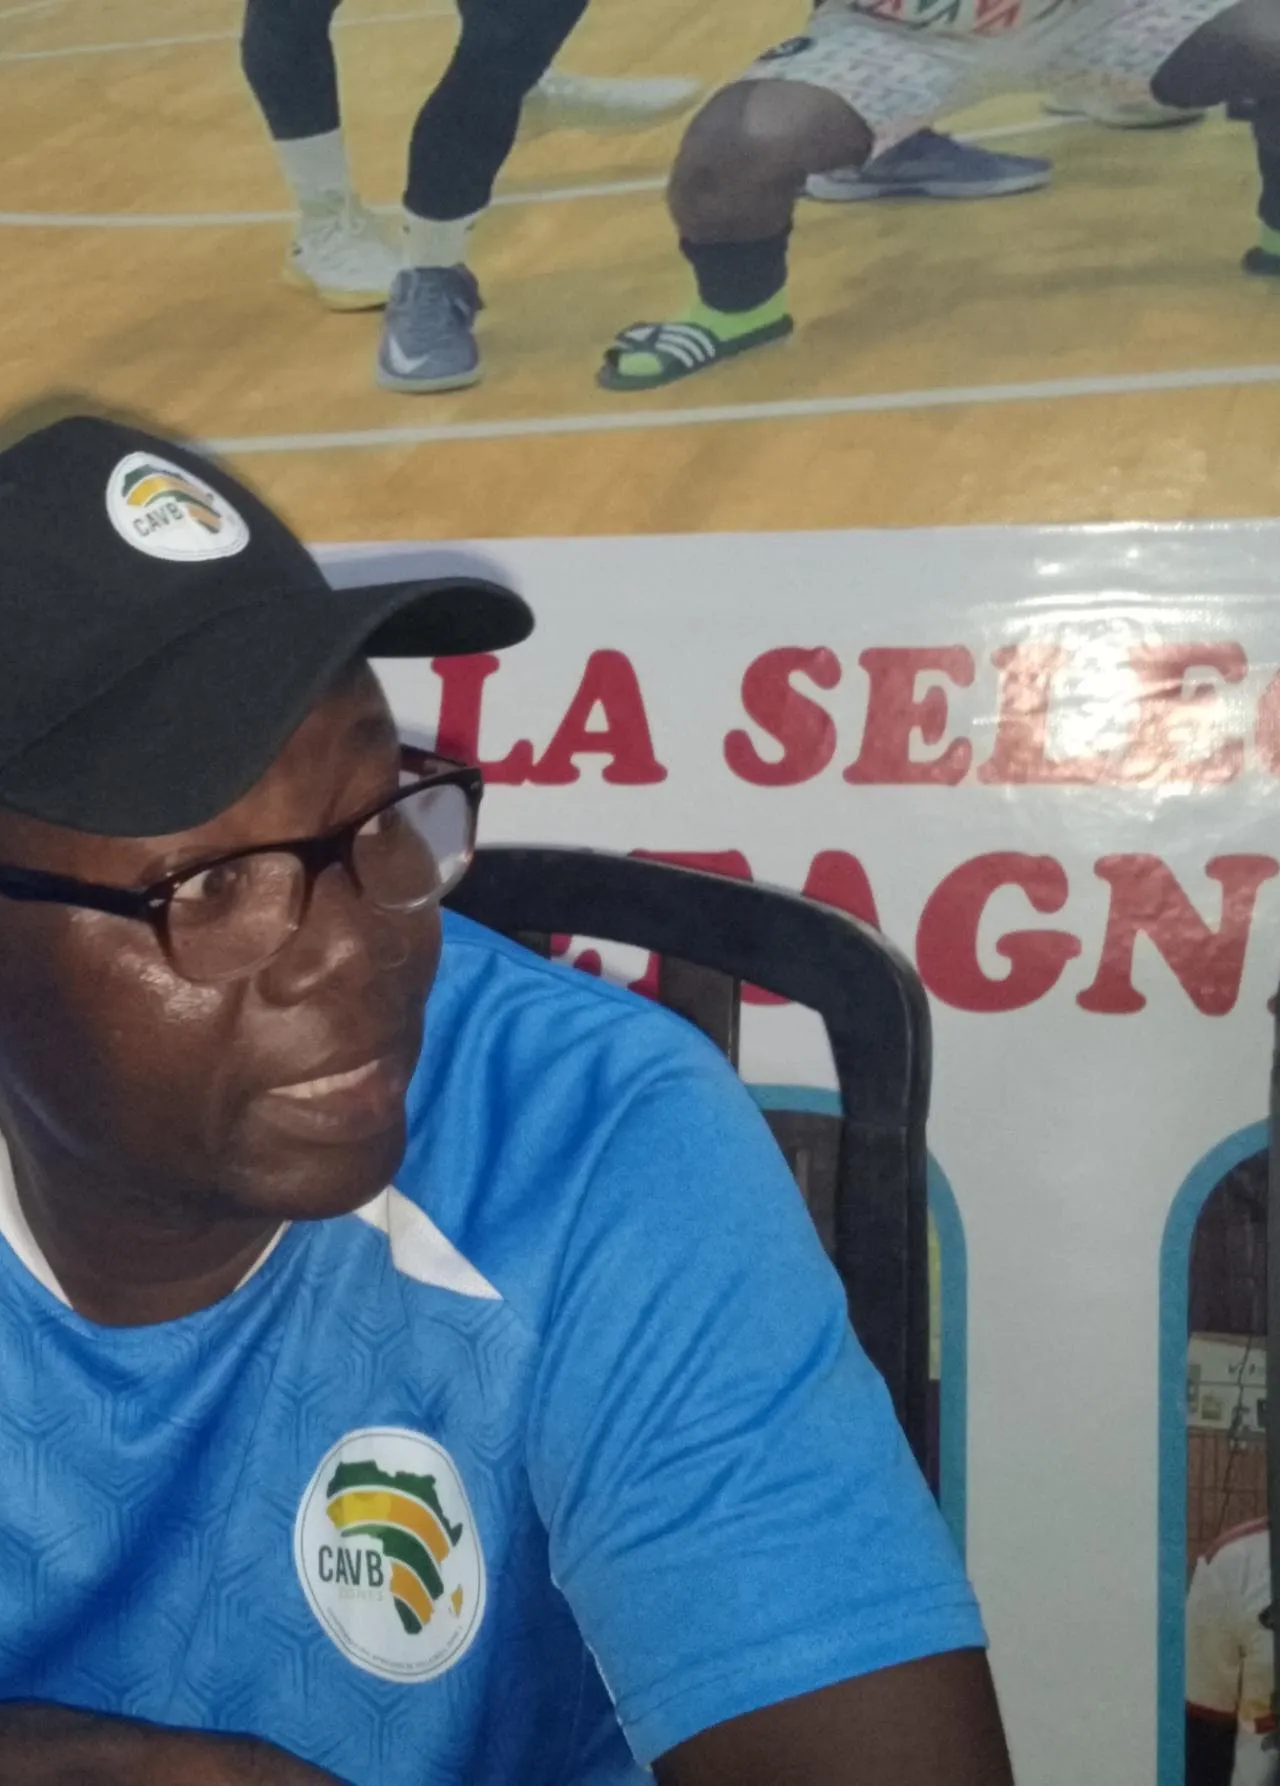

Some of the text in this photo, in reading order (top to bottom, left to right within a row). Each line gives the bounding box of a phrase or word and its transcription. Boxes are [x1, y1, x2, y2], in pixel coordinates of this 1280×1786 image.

[132, 502, 184, 537] CAVB
[430, 649, 666, 786] LA
[722, 642, 1280, 789] SELE
[318, 1545, 384, 1588] CAVB
